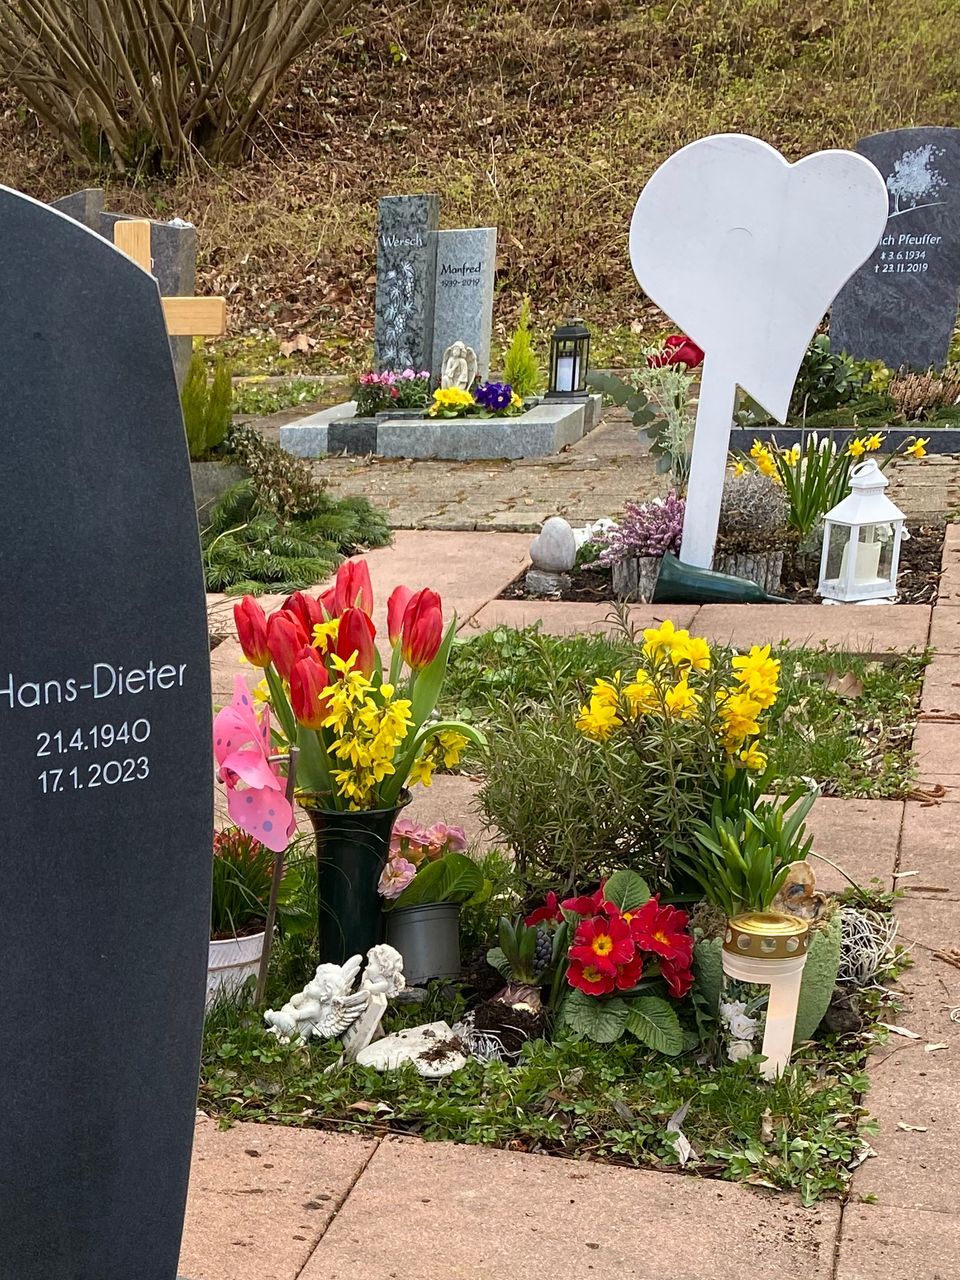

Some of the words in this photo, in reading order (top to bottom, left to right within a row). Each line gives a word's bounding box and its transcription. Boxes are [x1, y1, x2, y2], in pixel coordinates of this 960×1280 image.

[382, 233, 423, 247] Wersch
[880, 234, 895, 246] ich
[898, 233, 942, 245] Pfeuffer
[440, 262, 482, 276] Manfred
[36, 718, 152, 758] 21.4.1940
[37, 756, 151, 794] 17.1.2023
